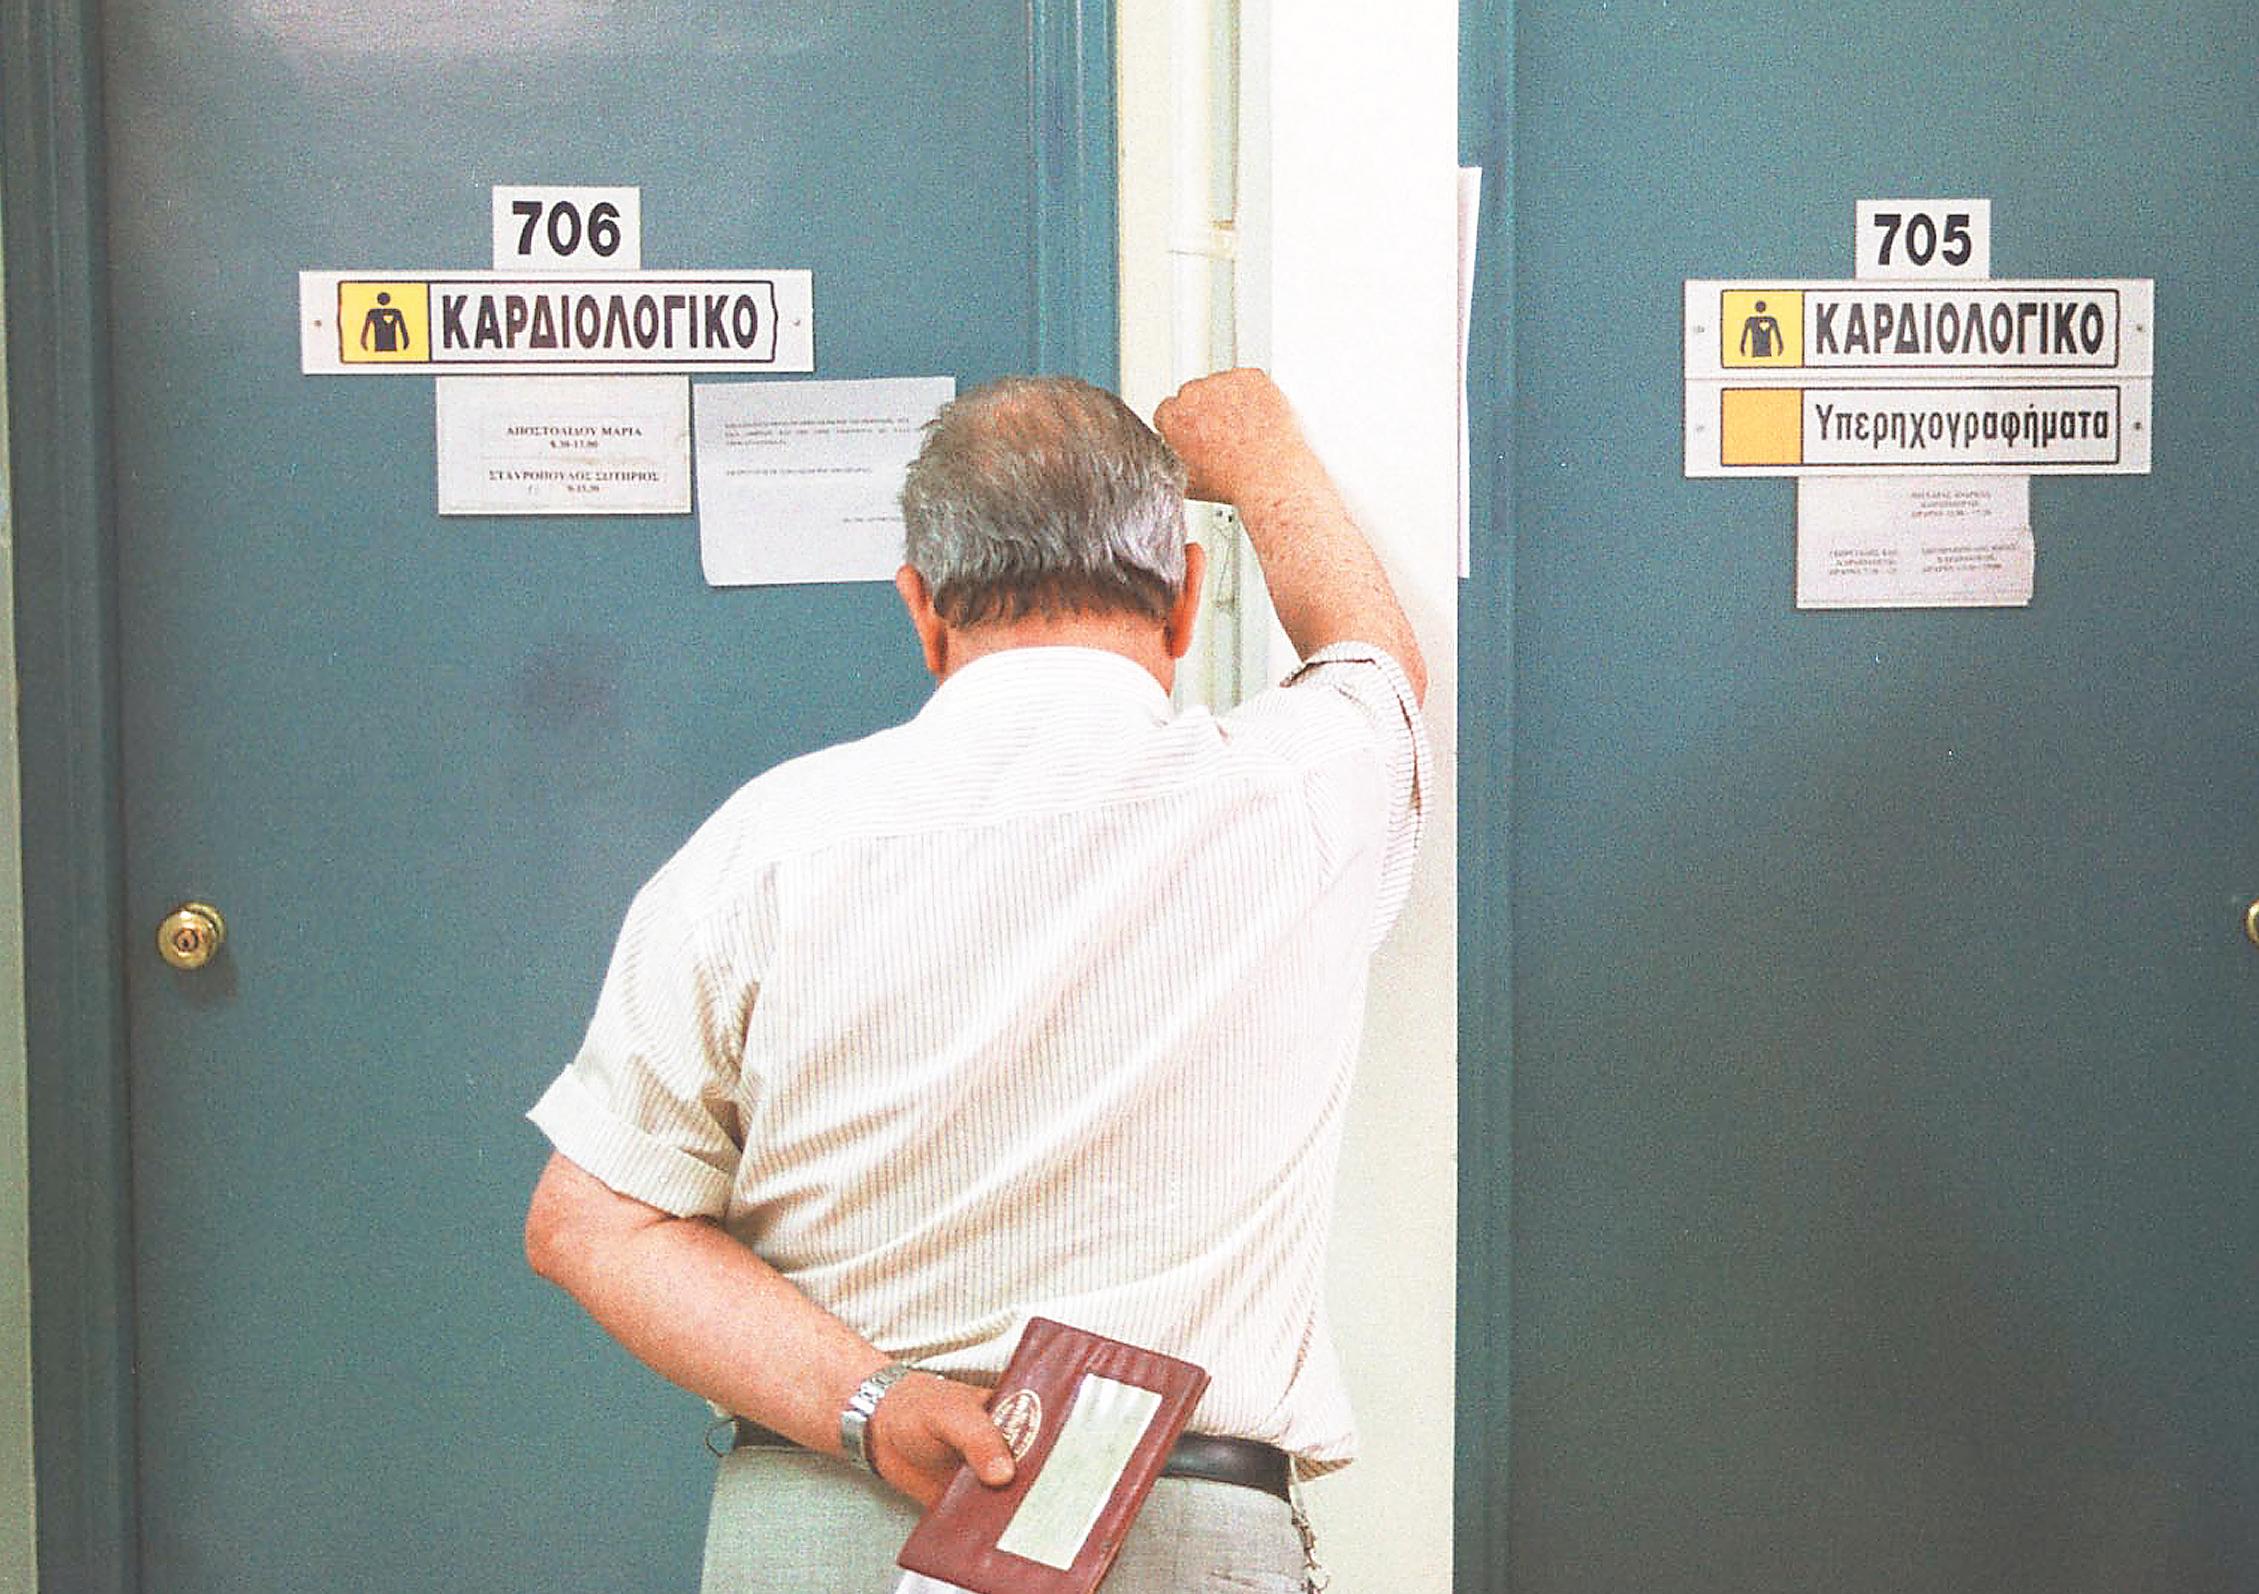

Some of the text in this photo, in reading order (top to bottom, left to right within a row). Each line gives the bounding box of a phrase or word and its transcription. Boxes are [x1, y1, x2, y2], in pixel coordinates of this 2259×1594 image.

[512, 200, 621, 257] 706
[1873, 213, 1973, 267] 705
[442, 294, 758, 350] ΚΑΡΔΙΟΛΟΓΙΚΟ
[1816, 302, 2104, 356] ΚΑΡΔΙΟΛΟΓΙΚΟ
[601, 426, 642, 436] ΜΑΡΙΑ
[1815, 402, 2109, 450] Υπερηχογραφήματα
